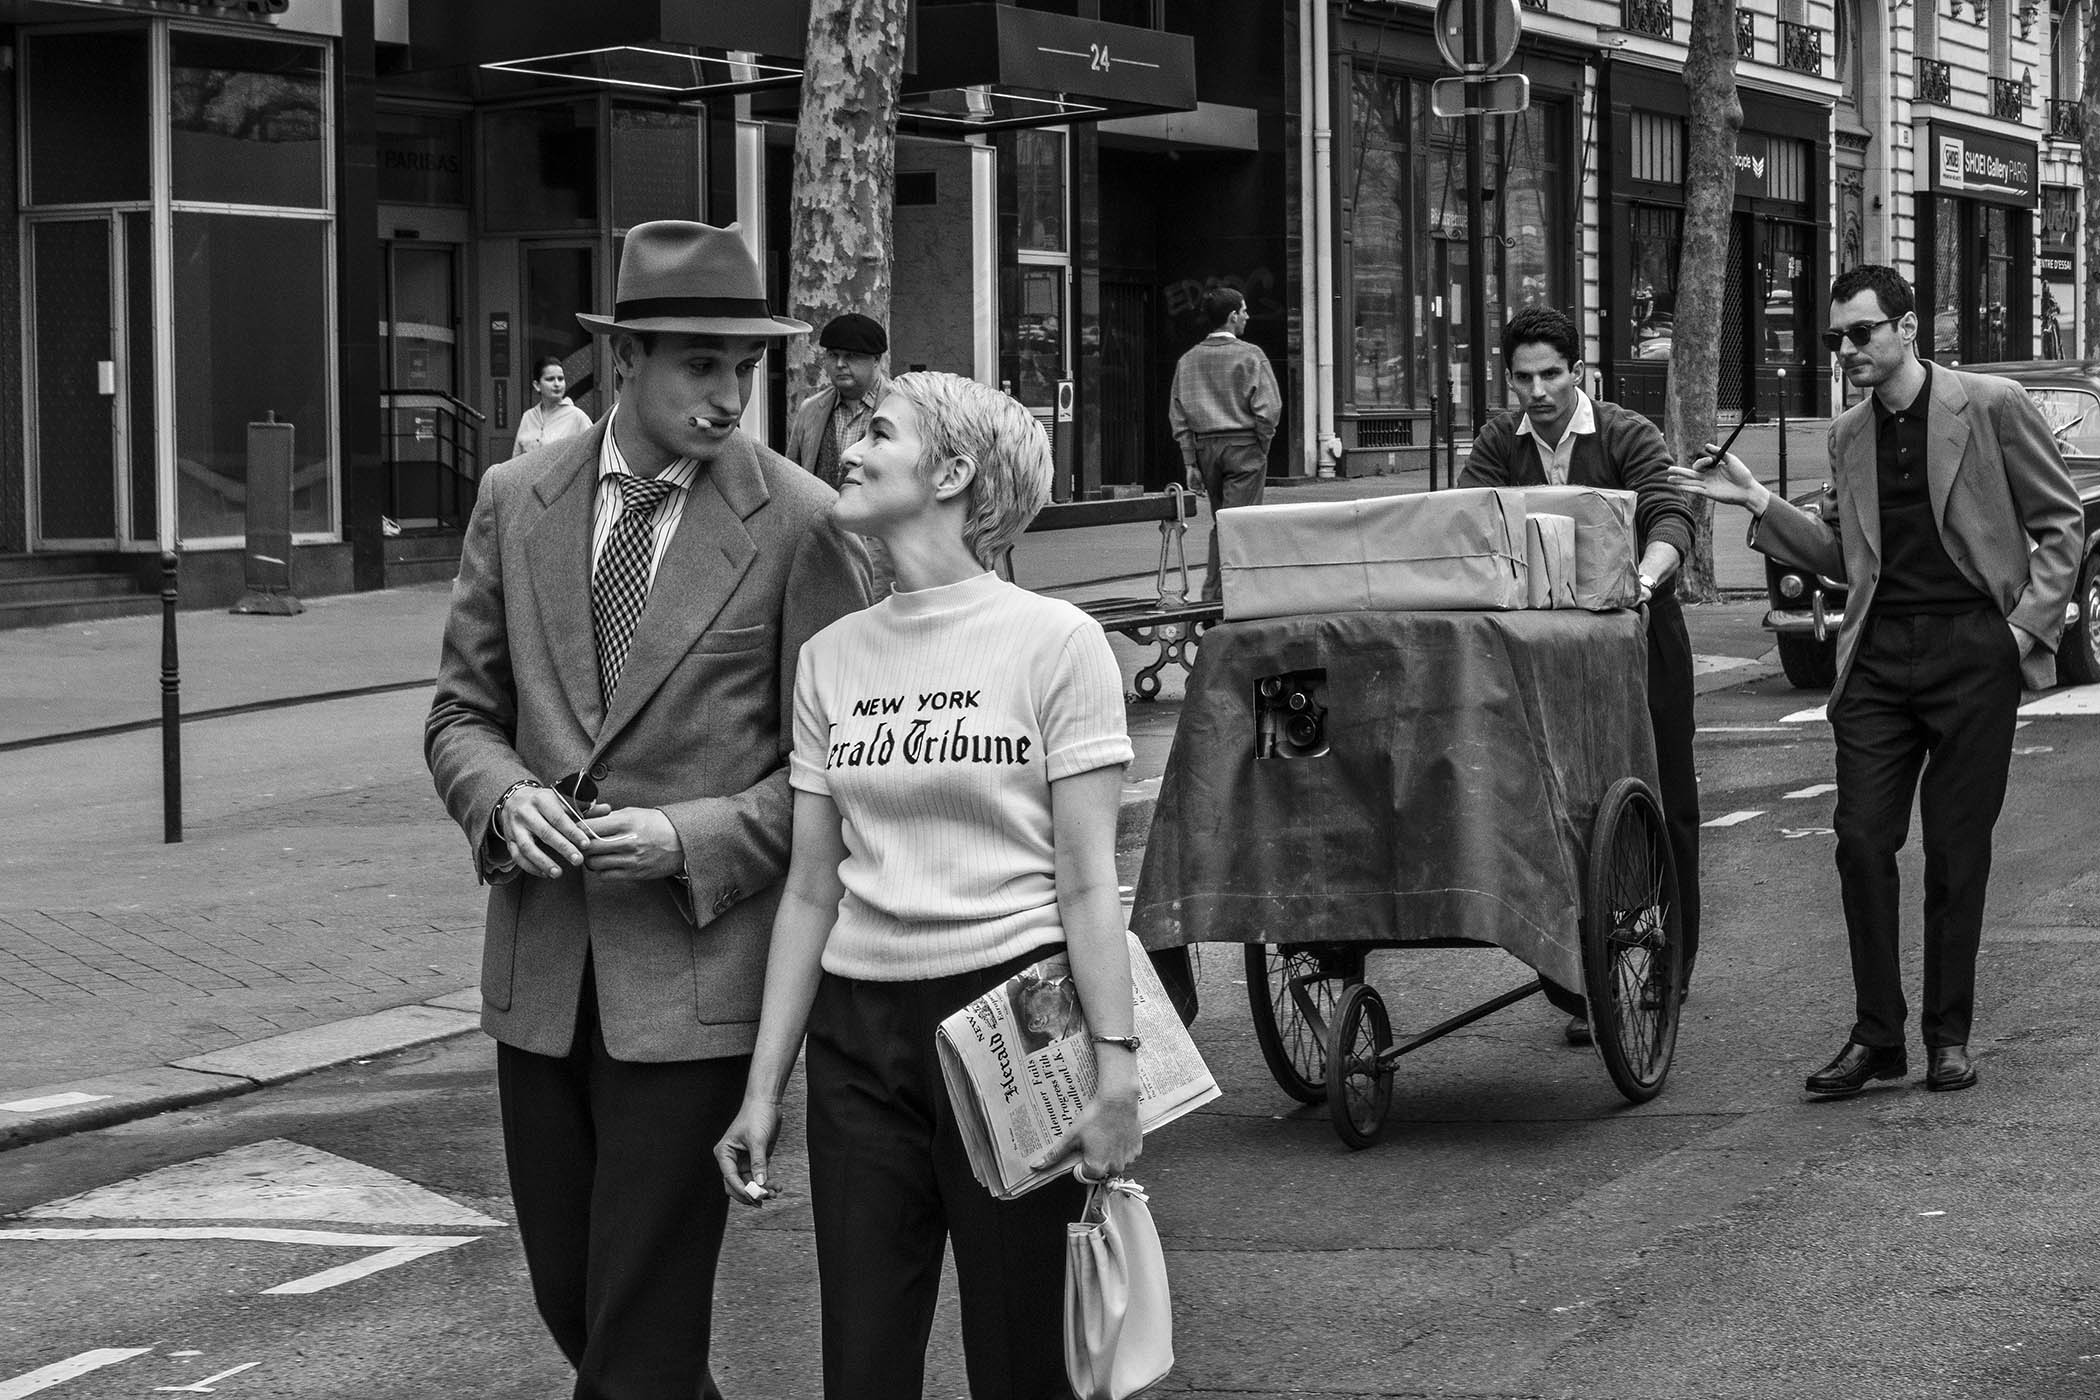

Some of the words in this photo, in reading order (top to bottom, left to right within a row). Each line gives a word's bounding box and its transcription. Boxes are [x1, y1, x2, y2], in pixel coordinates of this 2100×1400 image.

[1090, 43, 1111, 72] 24
[1734, 153, 1751, 171] ocycle
[1964, 150, 1986, 175] SHOEI
[1986, 155, 2009, 184] Gallery
[2009, 159, 2028, 183] PARIS
[852, 695, 905, 717] NEW
[917, 690, 981, 712] YORK
[903, 716, 1032, 766] Tribune
[966, 1015, 985, 1042] NEW
[989, 1032, 1020, 1104] Herald
[1027, 1058, 1043, 1086] Fails
[1039, 1054, 1055, 1079] With
[1063, 1071, 1073, 1085] on
[1051, 1078, 1073, 1122] Progress
[1066, 1084, 1084, 1115] aulle
